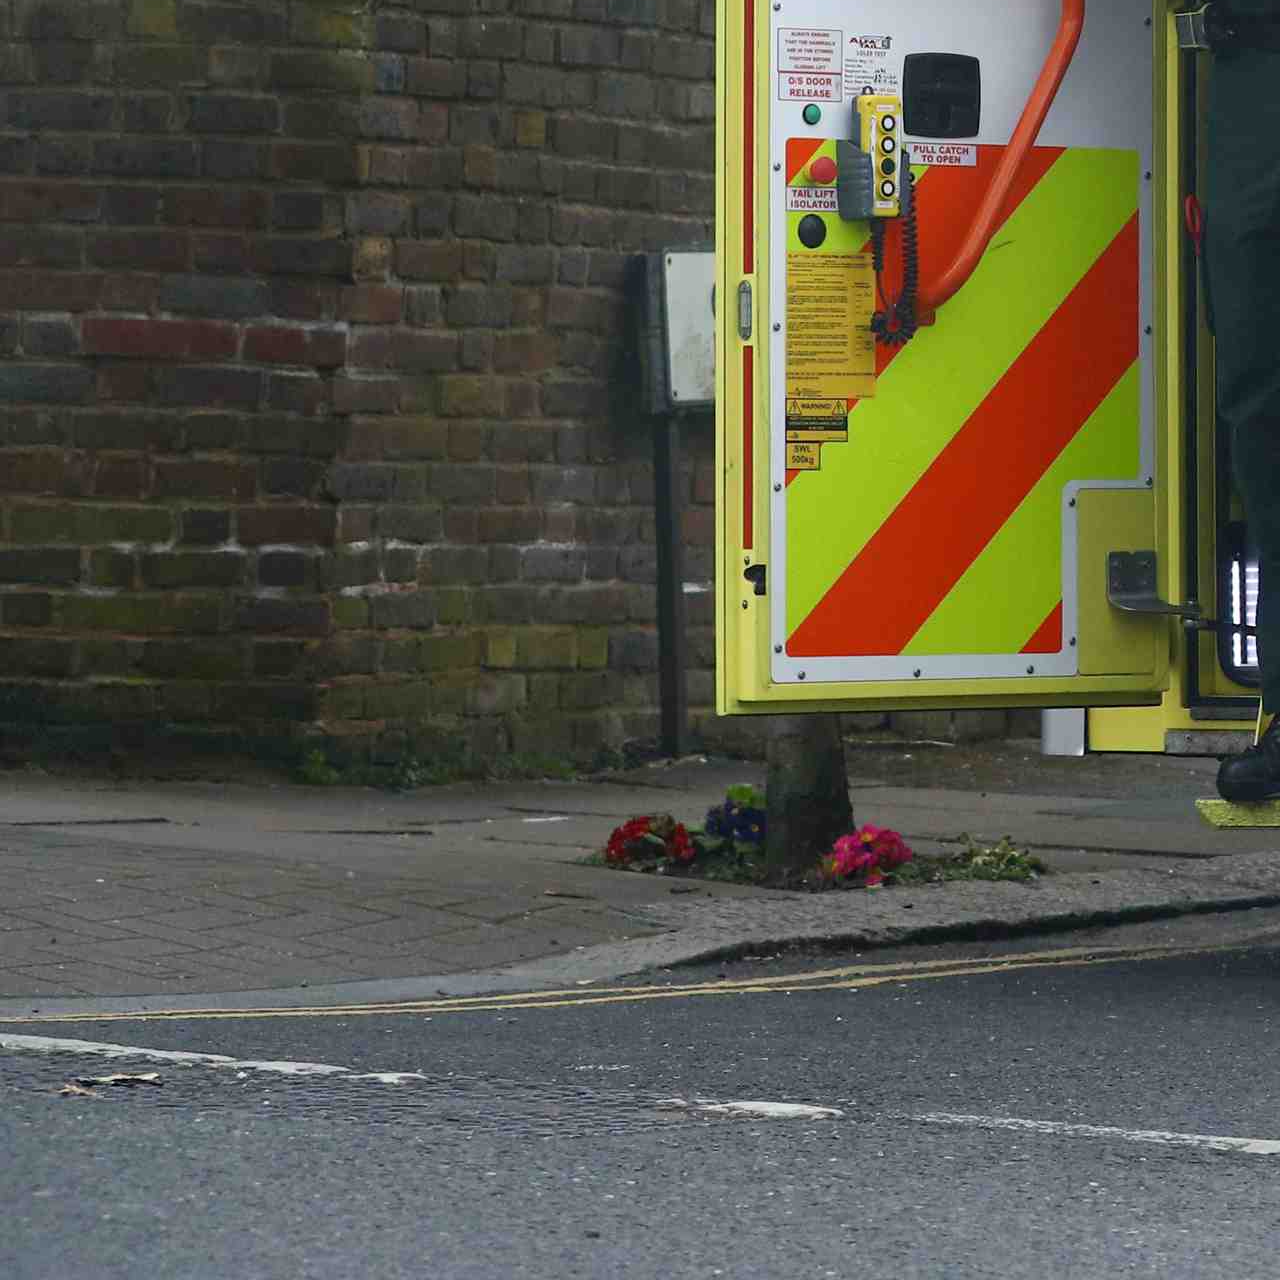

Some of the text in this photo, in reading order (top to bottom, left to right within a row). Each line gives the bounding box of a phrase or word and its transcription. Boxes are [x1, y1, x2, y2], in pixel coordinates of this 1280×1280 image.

[806, 77, 832, 86] DOOR
[789, 89, 832, 98] RELEASE
[913, 145, 969, 155] PULL CATCH
[921, 154, 961, 164] TO OPEN
[792, 189, 835, 199] TAIL LIFT
[790, 200, 837, 209] ISOLATOR
[794, 445, 812, 453] SWL
